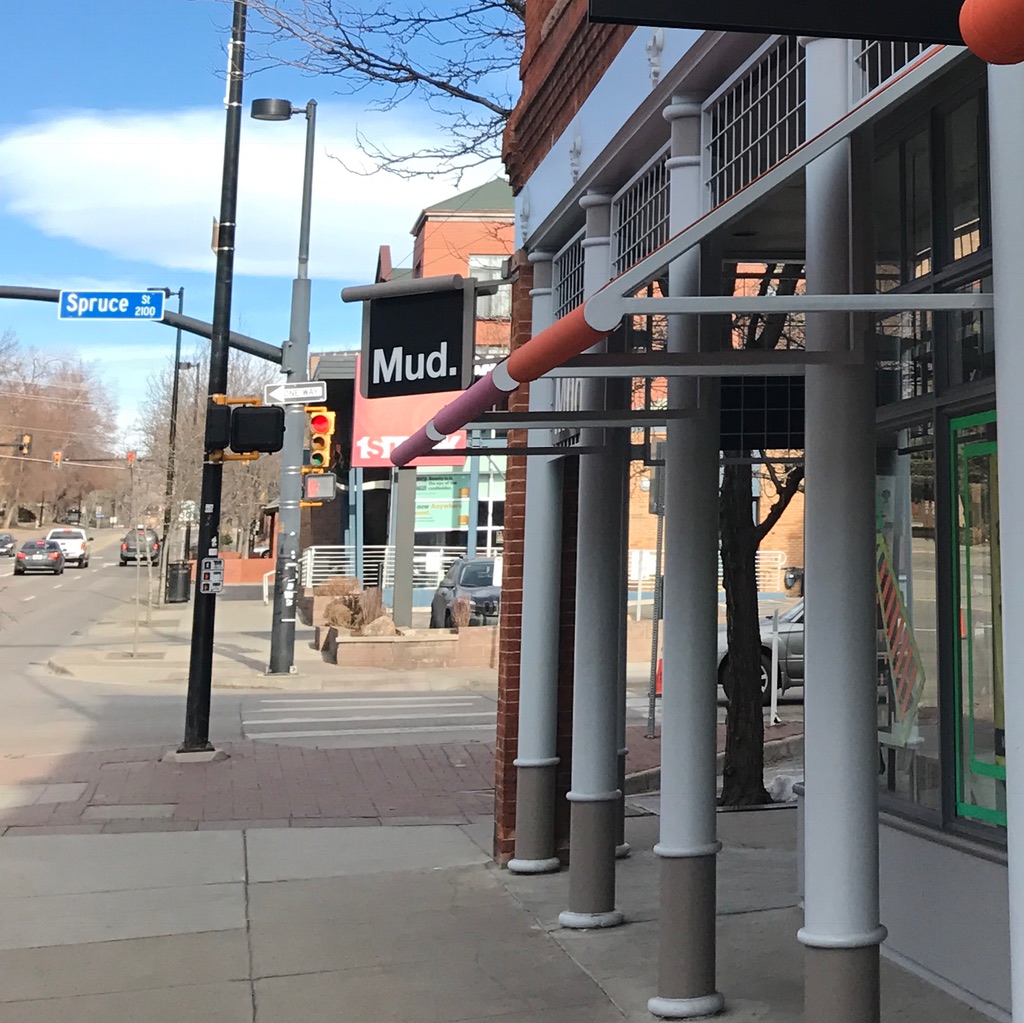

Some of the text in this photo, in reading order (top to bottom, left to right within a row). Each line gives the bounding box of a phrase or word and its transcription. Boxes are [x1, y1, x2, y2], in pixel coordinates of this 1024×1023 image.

[66, 293, 151, 317] Spruce St
[134, 306, 156, 317] 2100
[372, 341, 457, 384] Mud.
[284, 389, 299, 397] ONE
